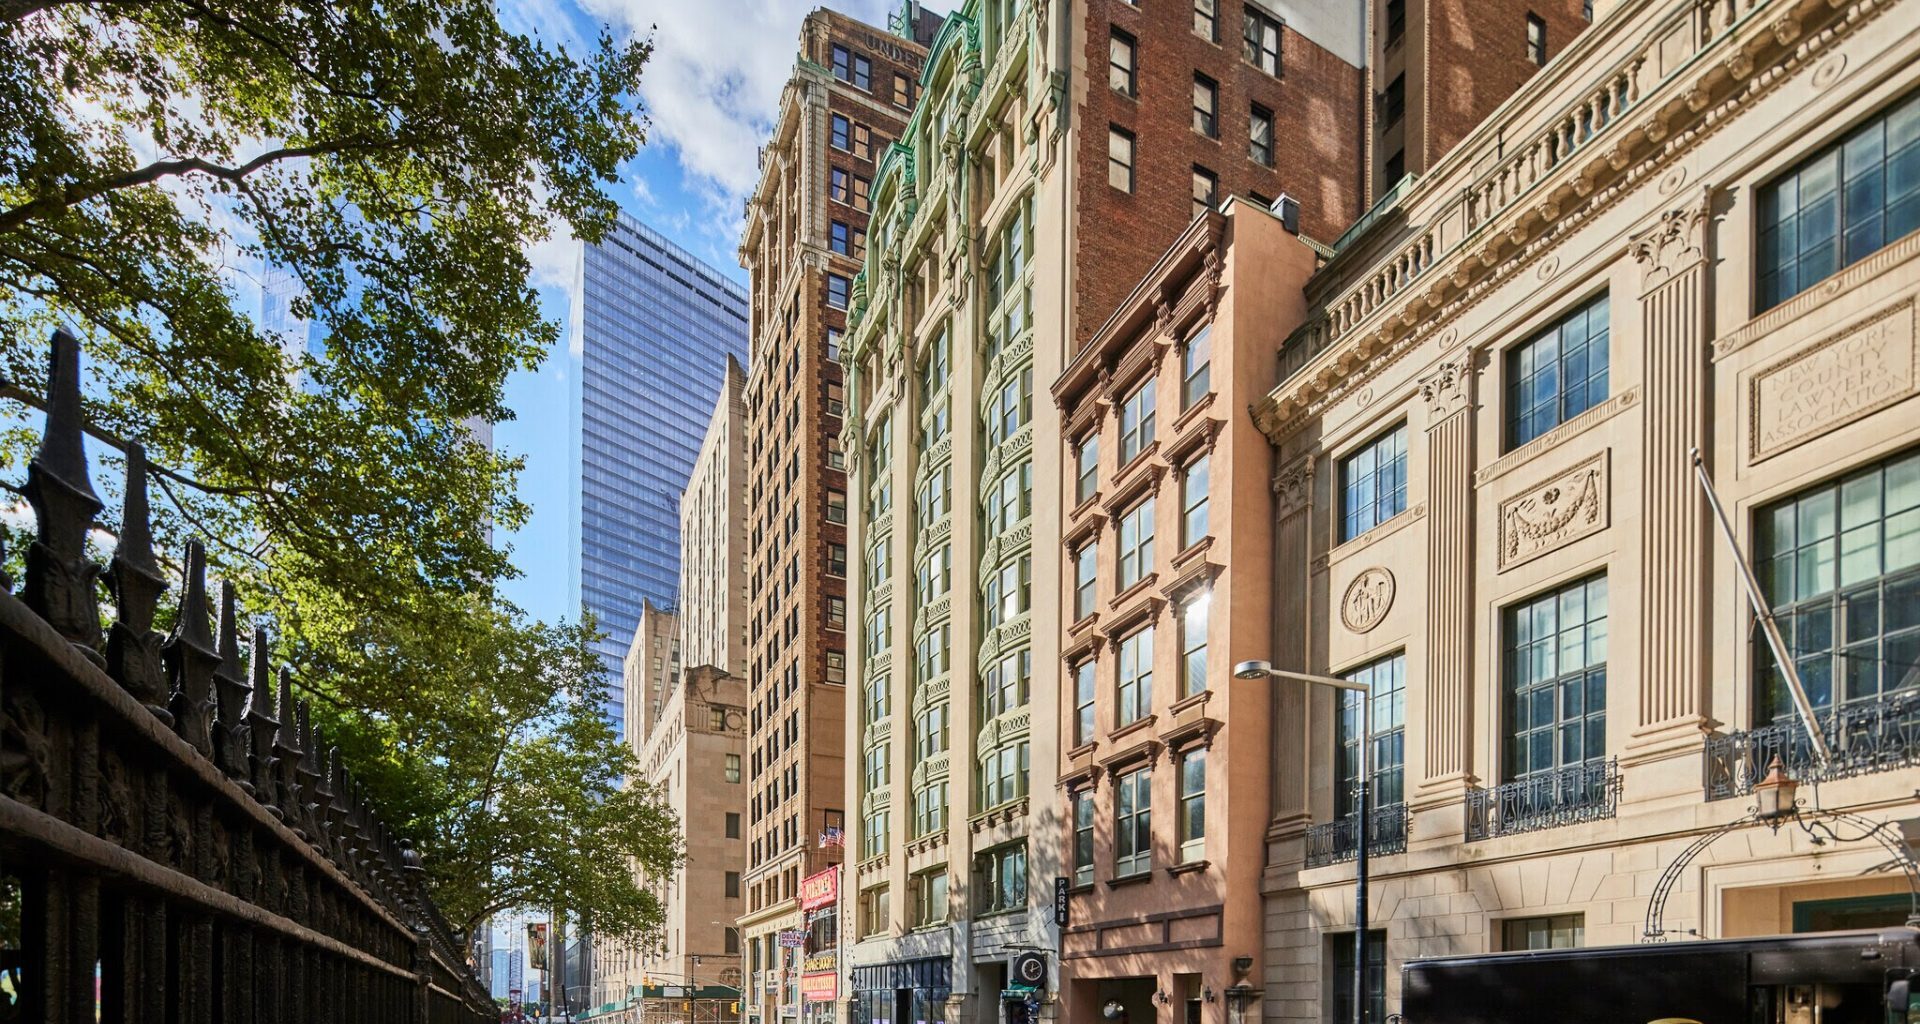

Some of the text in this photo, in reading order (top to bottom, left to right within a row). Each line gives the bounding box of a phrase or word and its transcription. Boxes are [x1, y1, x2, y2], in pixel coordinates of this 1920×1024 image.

[1771, 320, 1895, 392] NEW YORK
[1780, 341, 1888, 402] COUNTY
[1762, 367, 1909, 448] ASSOCIATION
[1778, 361, 1888, 423] LAWYERS
[1058, 879, 1066, 911] PARK
